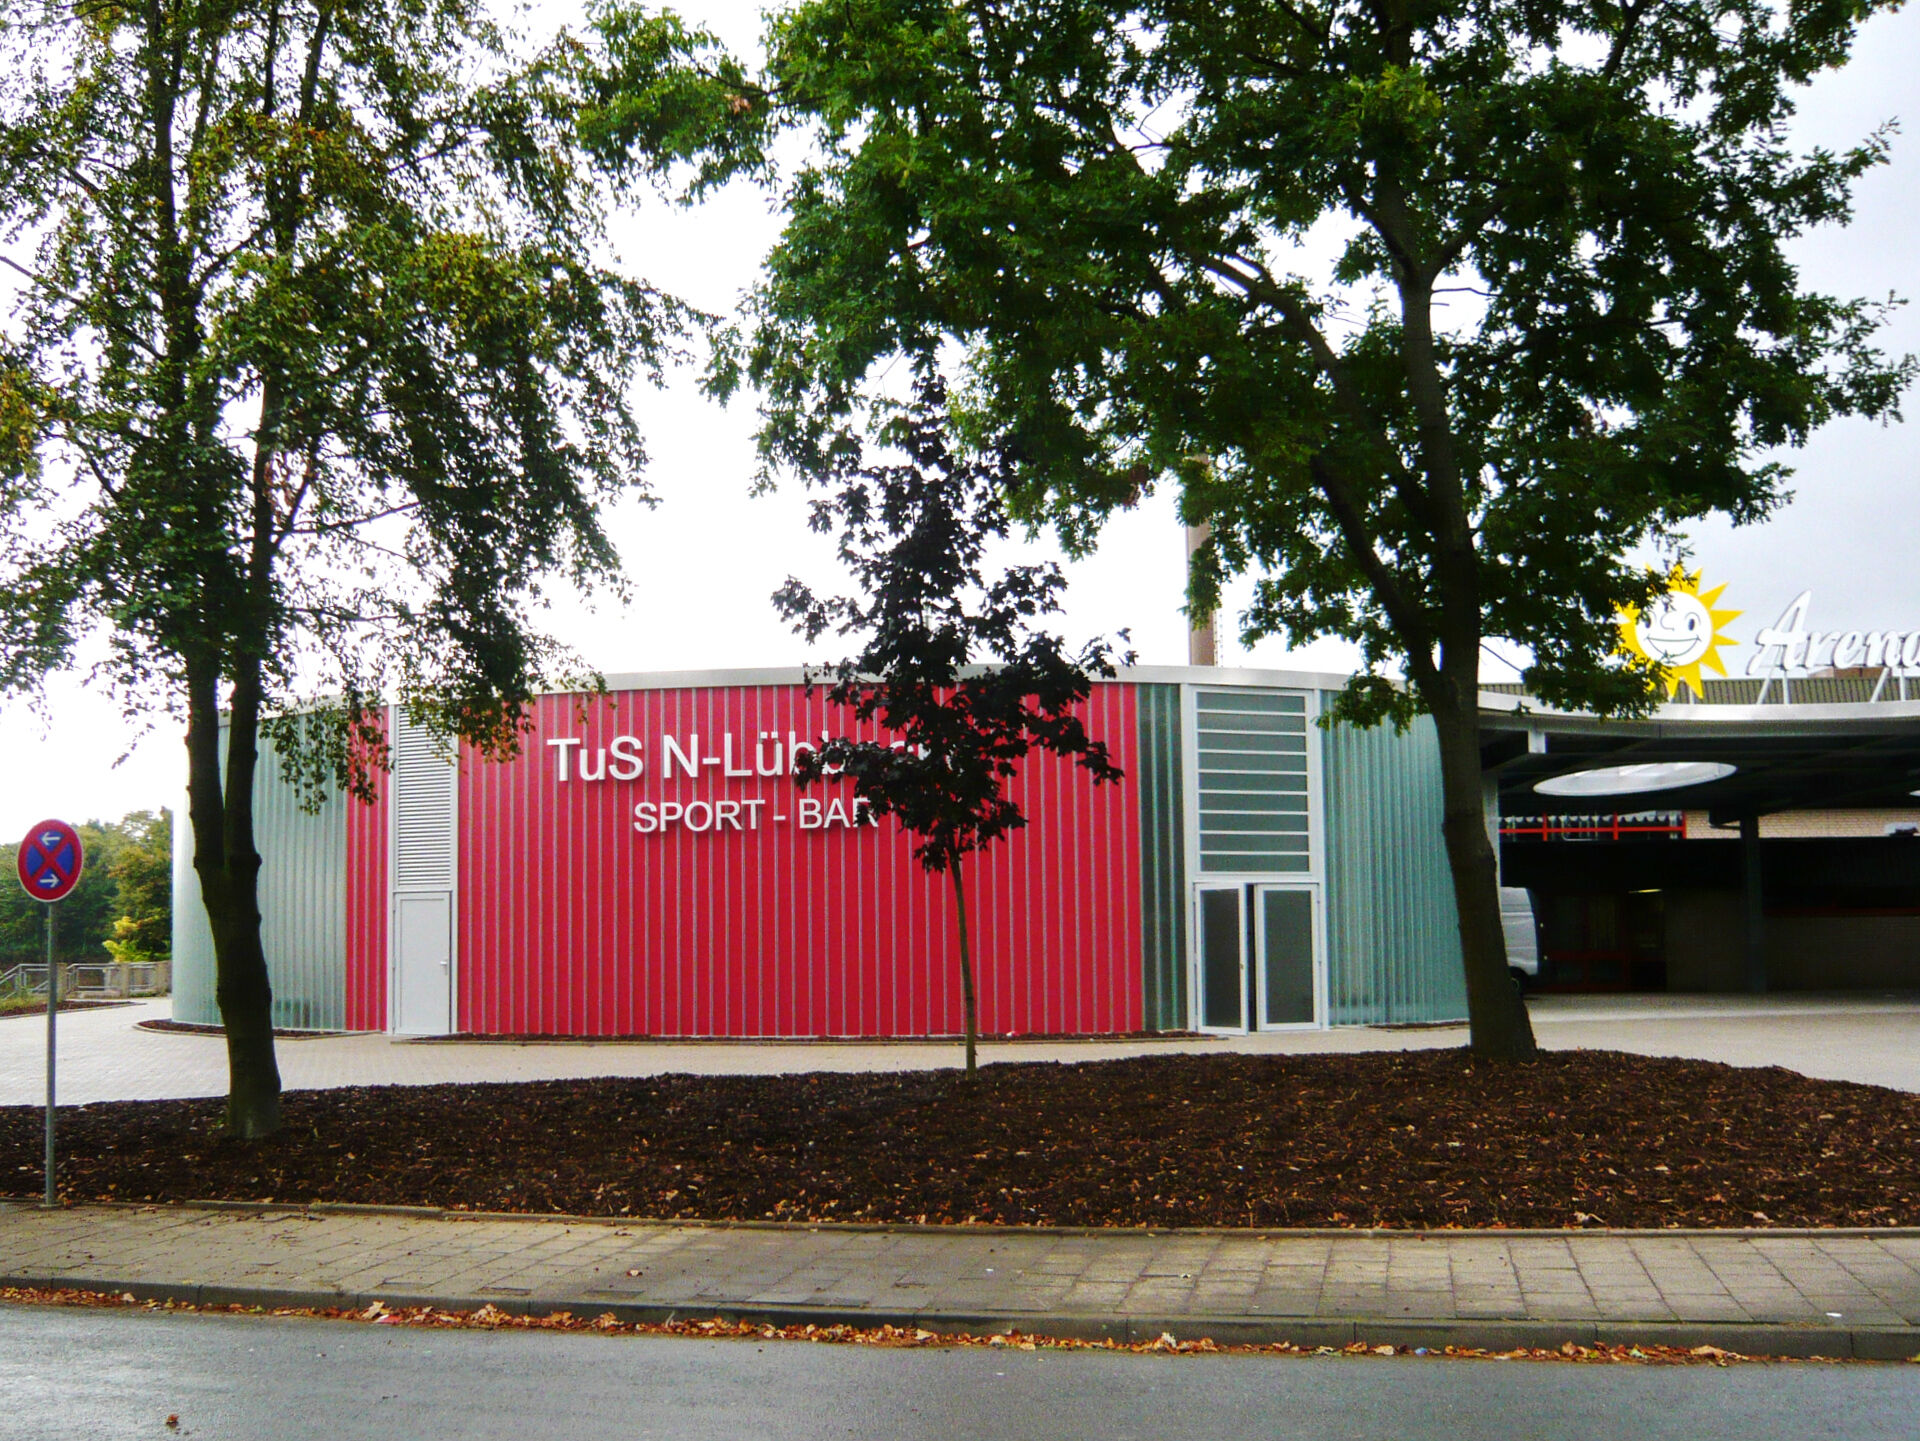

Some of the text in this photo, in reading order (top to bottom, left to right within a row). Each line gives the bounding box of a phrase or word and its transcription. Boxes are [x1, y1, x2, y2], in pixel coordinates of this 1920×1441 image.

[546, 730, 966, 782] TuS N-Lübb
[633, 799, 765, 833] SPORT
[799, 796, 879, 829] BAR
